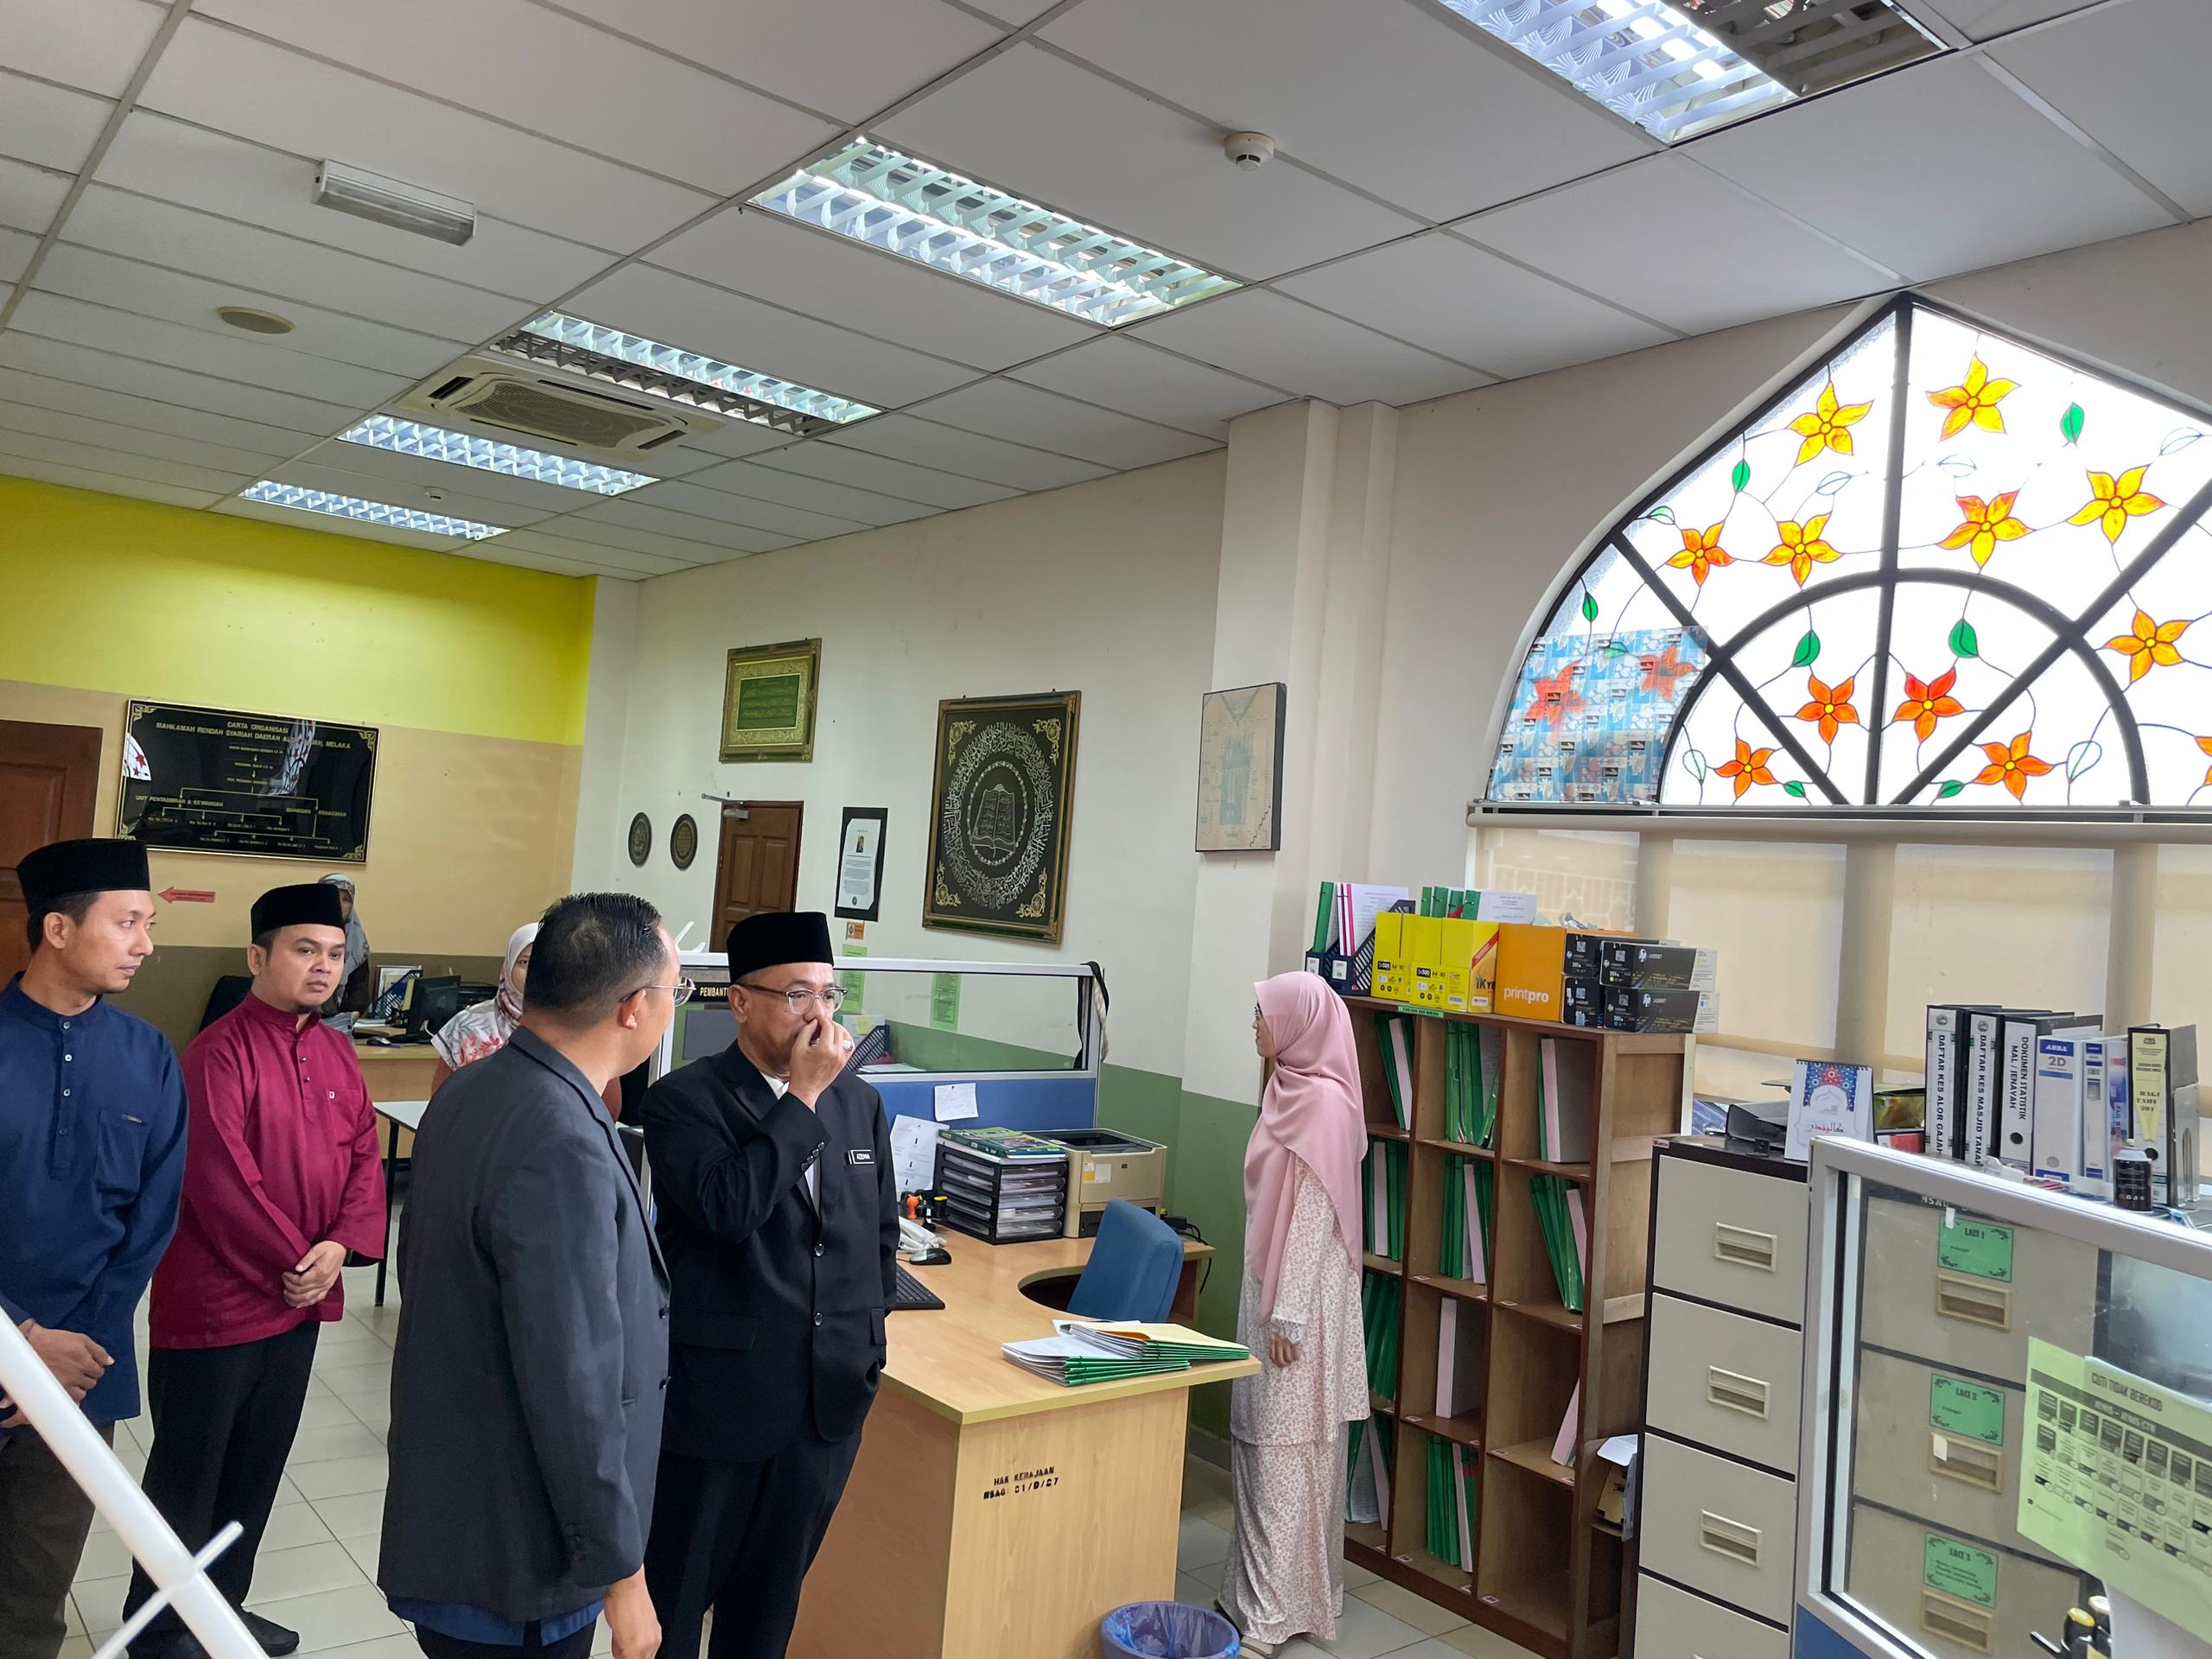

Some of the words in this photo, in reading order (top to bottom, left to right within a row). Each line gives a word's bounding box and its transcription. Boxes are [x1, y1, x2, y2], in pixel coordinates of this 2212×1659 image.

[156, 722, 195, 734] MAHKAMAH
[197, 726, 224, 735] RENDAH
[226, 729, 253, 739] SYARIAH
[254, 732, 281, 742] DAERAH
[326, 741, 351, 749] MELAKA
[226, 721, 248, 730] CARTA
[251, 723, 289, 734] ORGANISASI
[700, 986, 728, 997] PEMBANT
[1503, 987, 1549, 1004] printpro
[2020, 1037, 2029, 1080] DOKUMEN
[2048, 1056, 2066, 1067] 2D
[2009, 1070, 2018, 1109] JENAYAH
[2018, 1081, 2027, 1120] STATISTIK
[1975, 1096, 1984, 1133] MASJID
[1972, 1392, 1977, 1401] 2
[994, 1476, 1009, 1486] HAK
[1014, 1466, 1054, 1482] KERAJAAN
